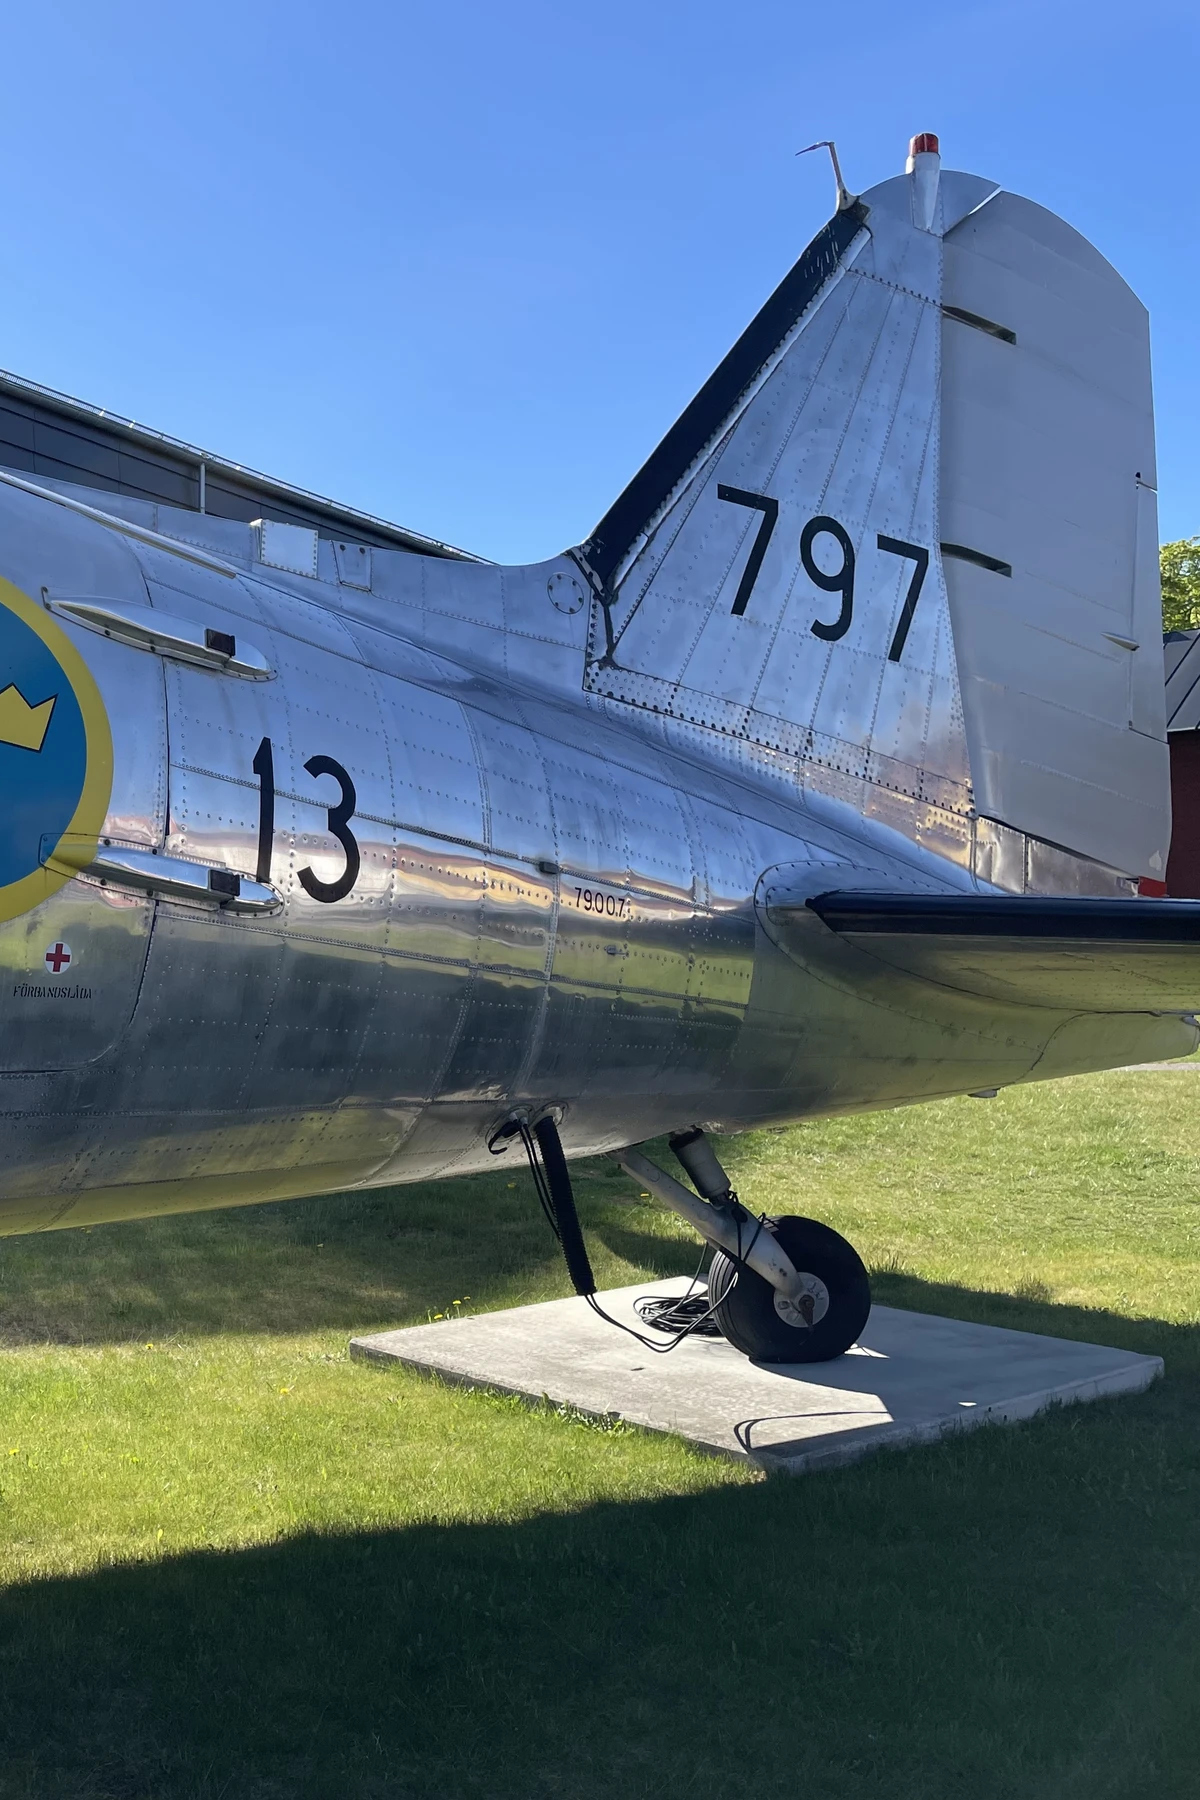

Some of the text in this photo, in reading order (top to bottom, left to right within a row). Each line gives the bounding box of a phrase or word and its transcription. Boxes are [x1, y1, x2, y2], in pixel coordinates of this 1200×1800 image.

[717, 483, 929, 662] 797
[253, 737, 360, 903] 13
[13, 984, 92, 999] FÖRBANDSLÅDA
